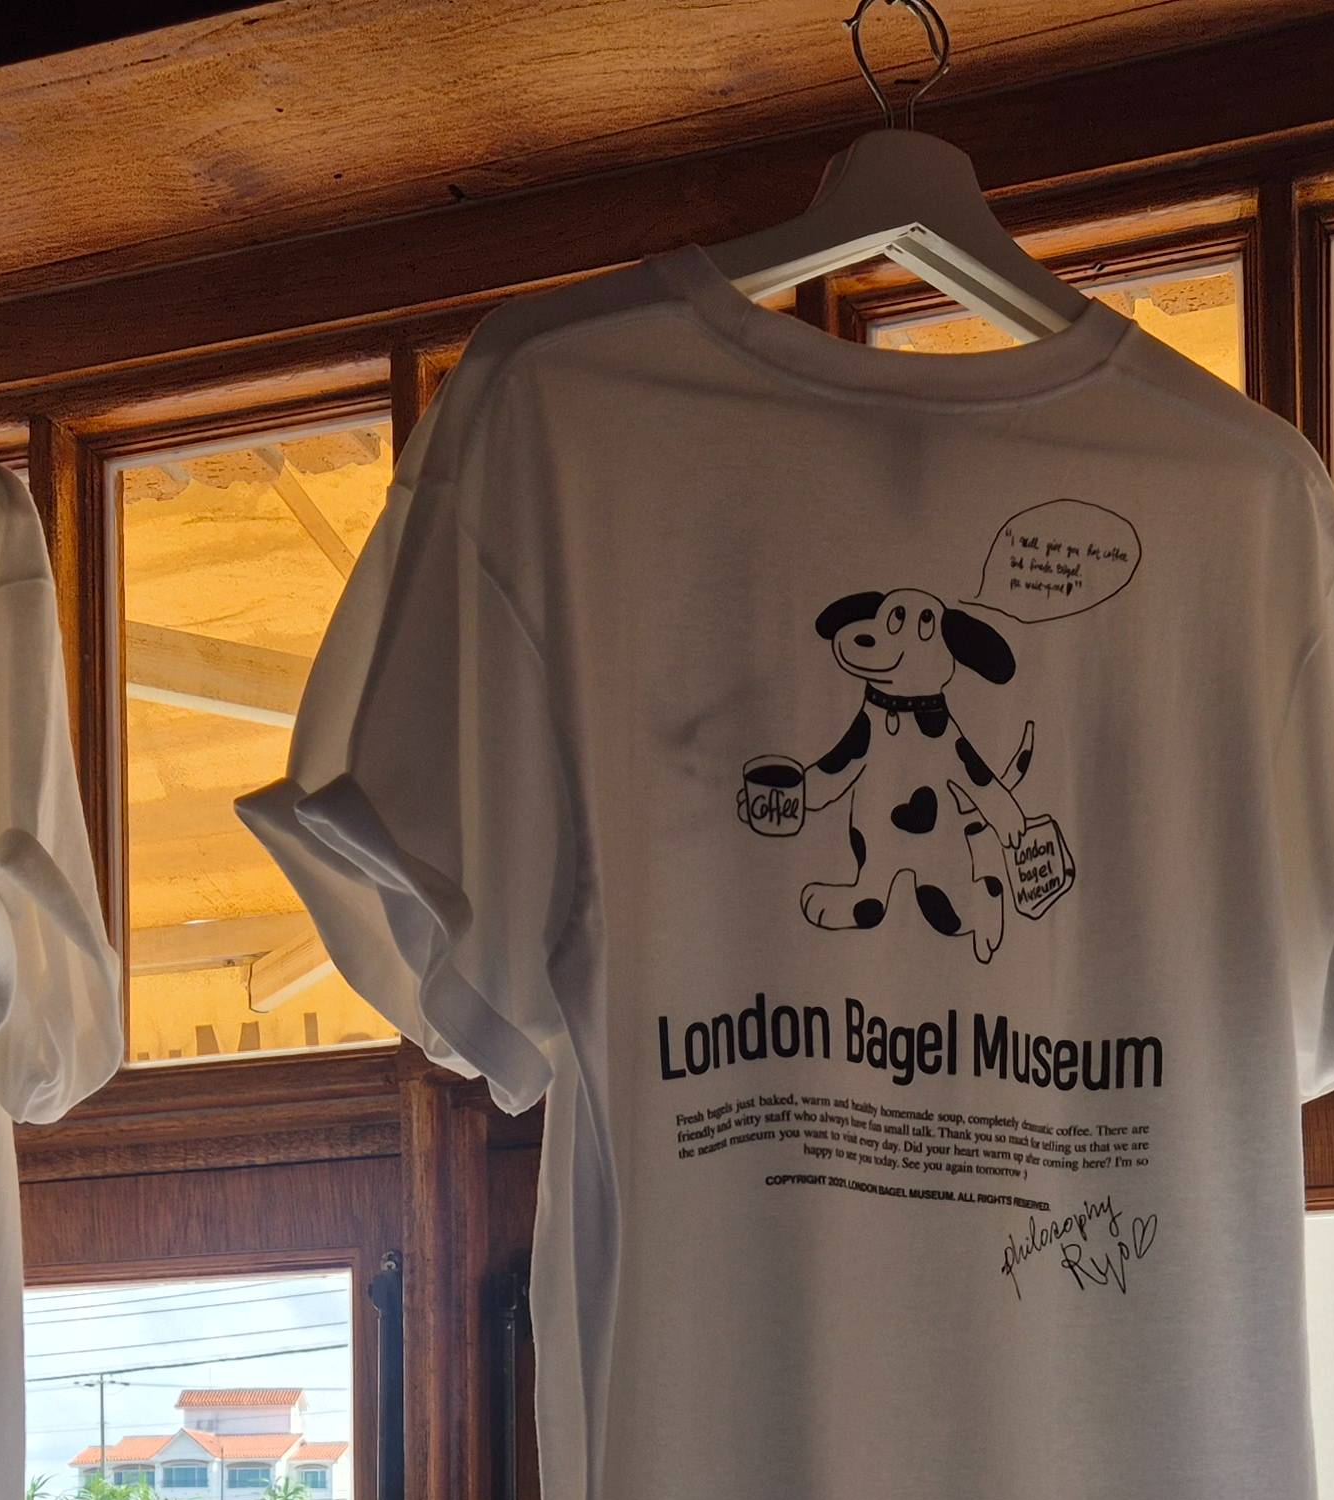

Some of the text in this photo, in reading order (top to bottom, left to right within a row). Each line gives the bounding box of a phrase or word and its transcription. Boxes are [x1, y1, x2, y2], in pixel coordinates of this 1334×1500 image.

[751, 789, 799, 826] Coffee
[1015, 839, 1055, 865] London
[1018, 860, 1052, 883] bagel
[657, 991, 1165, 1091] London Bagel Museum
[676, 1094, 1149, 1136] Fresh just baked, warm and homemade soup, completely coffee. There are
[677, 1124, 715, 1143] friendly
[717, 1119, 732, 1133] and
[734, 1112, 761, 1128] witty
[765, 1110, 792, 1123] staff
[794, 1112, 817, 1122] who
[819, 1112, 850, 1128] always
[883, 1122, 909, 1137] small
[912, 1126, 935, 1137] talk.
[938, 1127, 971, 1140] Thank
[974, 1132, 992, 1145] you
[995, 1133, 1006, 1143] so
[1074, 1143, 1086, 1152] us
[1089, 1142, 1110, 1152] that
[1132, 1142, 1149, 1150] are
[679, 1147, 694, 1159] the
[730, 1130, 775, 1146] museum
[779, 1130, 800, 1143] you
[804, 1129, 828, 1139] want
[831, 1131, 839, 1141] to
[882, 1139, 901, 1154] day.
[904, 1141, 922, 1154] Did
[926, 1142, 950, 1155] your
[954, 1144, 979, 1158] heart
[983, 1149, 1011, 1160] warm
[1043, 1157, 1078, 1171] coming
[1082, 1158, 1111, 1168] here?
[1136, 1158, 1149, 1166] so
[803, 1143, 833, 1159] happy
[836, 1148, 844, 1158] to
[896, 1158, 920, 1170] See
[923, 1159, 942, 1172] you
[946, 1161, 973, 1175] again
[765, 1175, 827, 1186] COPYRIGHT
[958, 1191, 975, 1203] ALL
[978, 1194, 1012, 1206] RIGHTS
